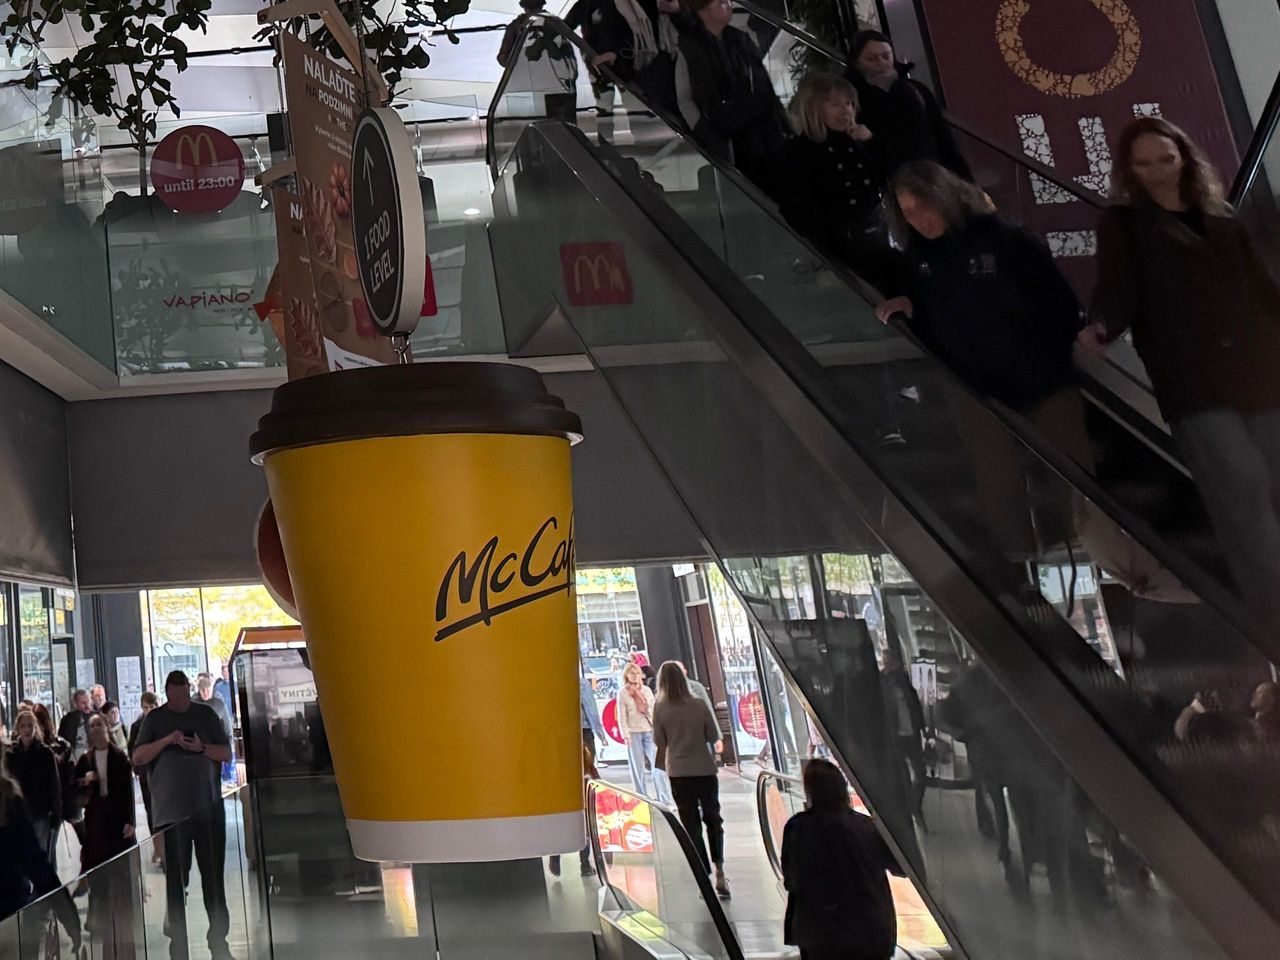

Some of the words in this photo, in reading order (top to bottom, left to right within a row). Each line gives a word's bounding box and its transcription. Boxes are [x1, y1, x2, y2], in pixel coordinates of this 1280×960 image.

[304, 54, 356, 103] NALAĎTE
[164, 178, 195, 193] until
[197, 175, 235, 190] 23:00
[369, 210, 390, 255] FOOD
[370, 248, 395, 294] LEVEL
